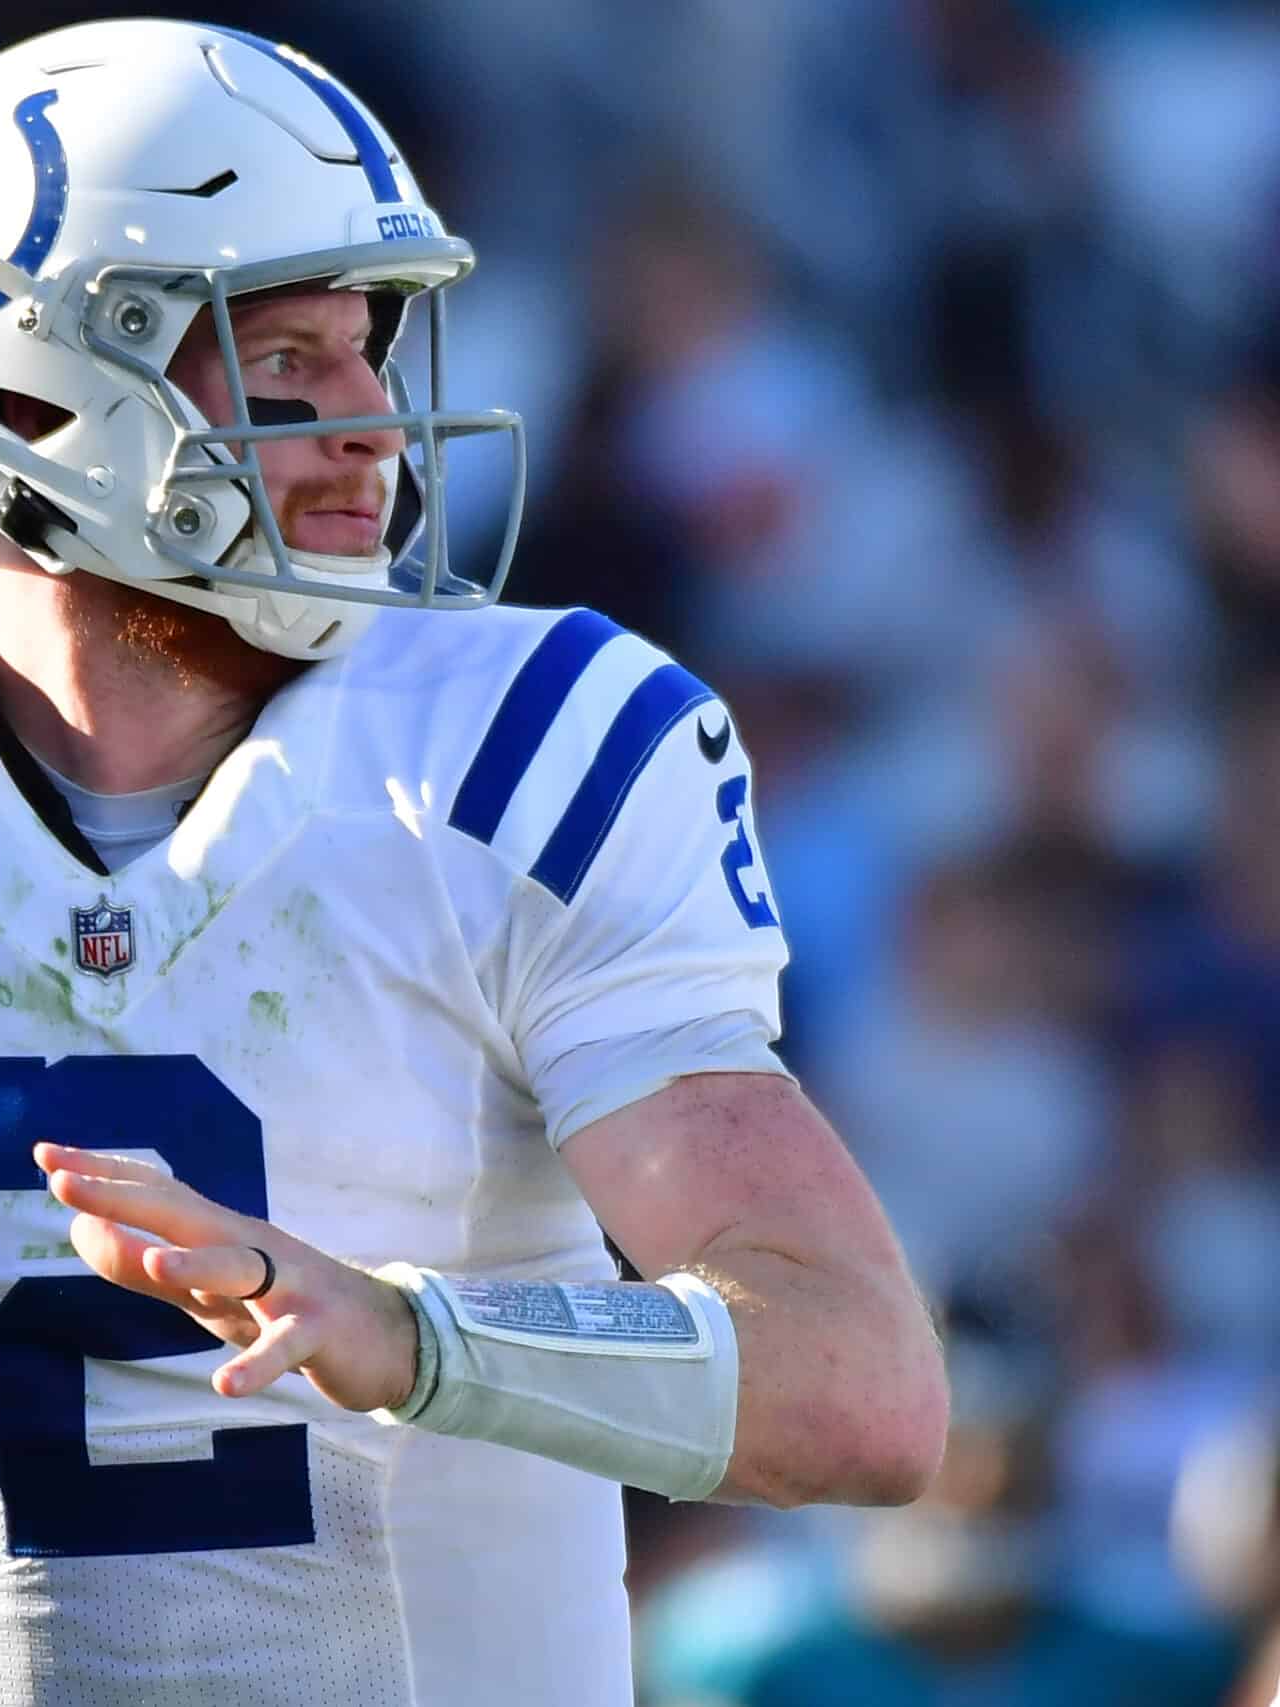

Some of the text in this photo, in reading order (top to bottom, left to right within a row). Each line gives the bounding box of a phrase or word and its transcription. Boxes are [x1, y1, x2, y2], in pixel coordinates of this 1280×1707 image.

[376, 213, 434, 240] COLTS
[716, 774, 780, 929] 2
[81, 935, 128, 967] NFL
